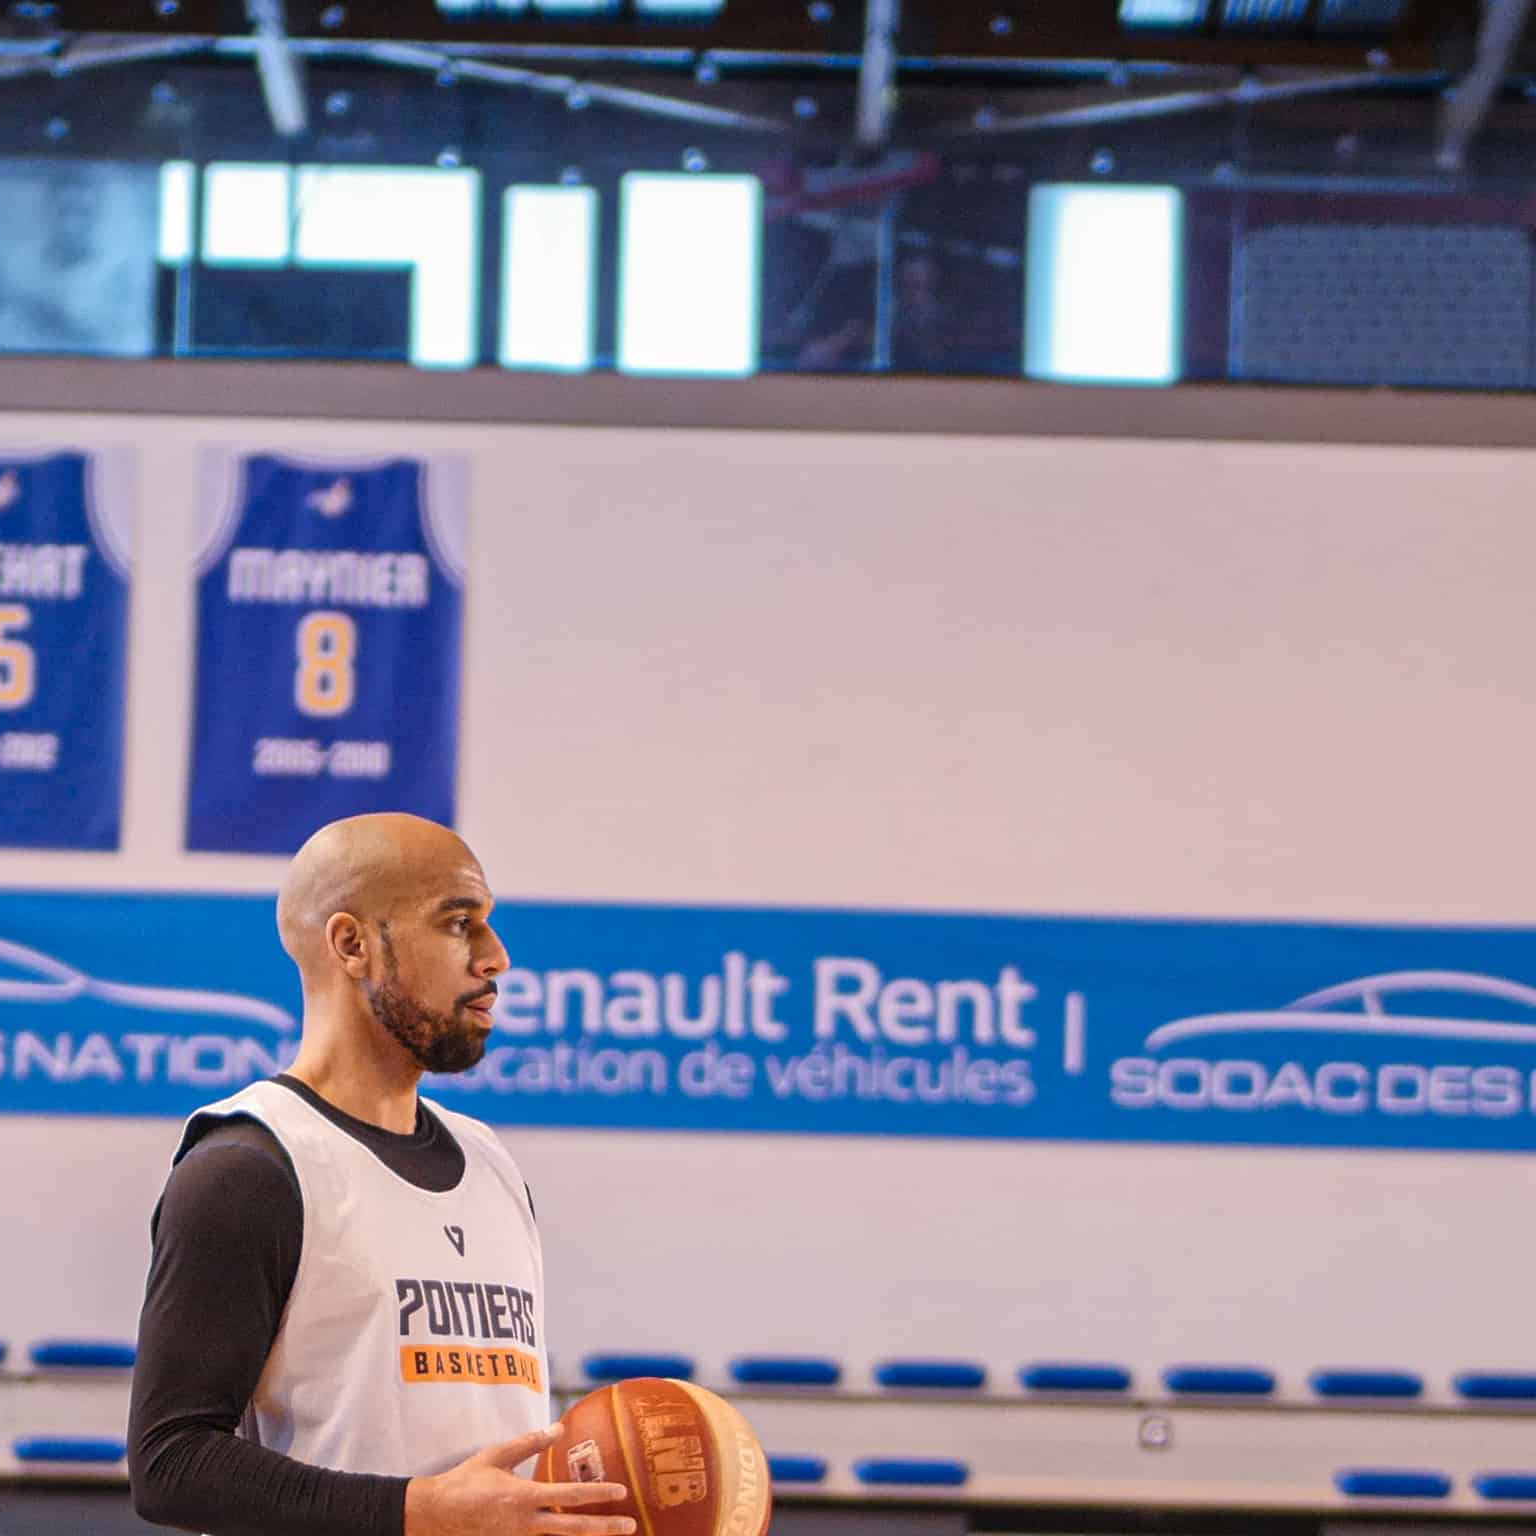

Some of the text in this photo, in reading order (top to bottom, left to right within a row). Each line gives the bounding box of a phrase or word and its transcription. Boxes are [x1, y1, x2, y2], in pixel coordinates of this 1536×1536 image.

[295, 610, 356, 718] 8
[491, 950, 1038, 1047] enault Rent
[13, 1031, 302, 1086] NATION
[678, 1042, 756, 1098] de
[764, 1043, 1035, 1106] véhicules
[1377, 1064, 1522, 1118] DES
[396, 1279, 536, 1347] POITIERS
